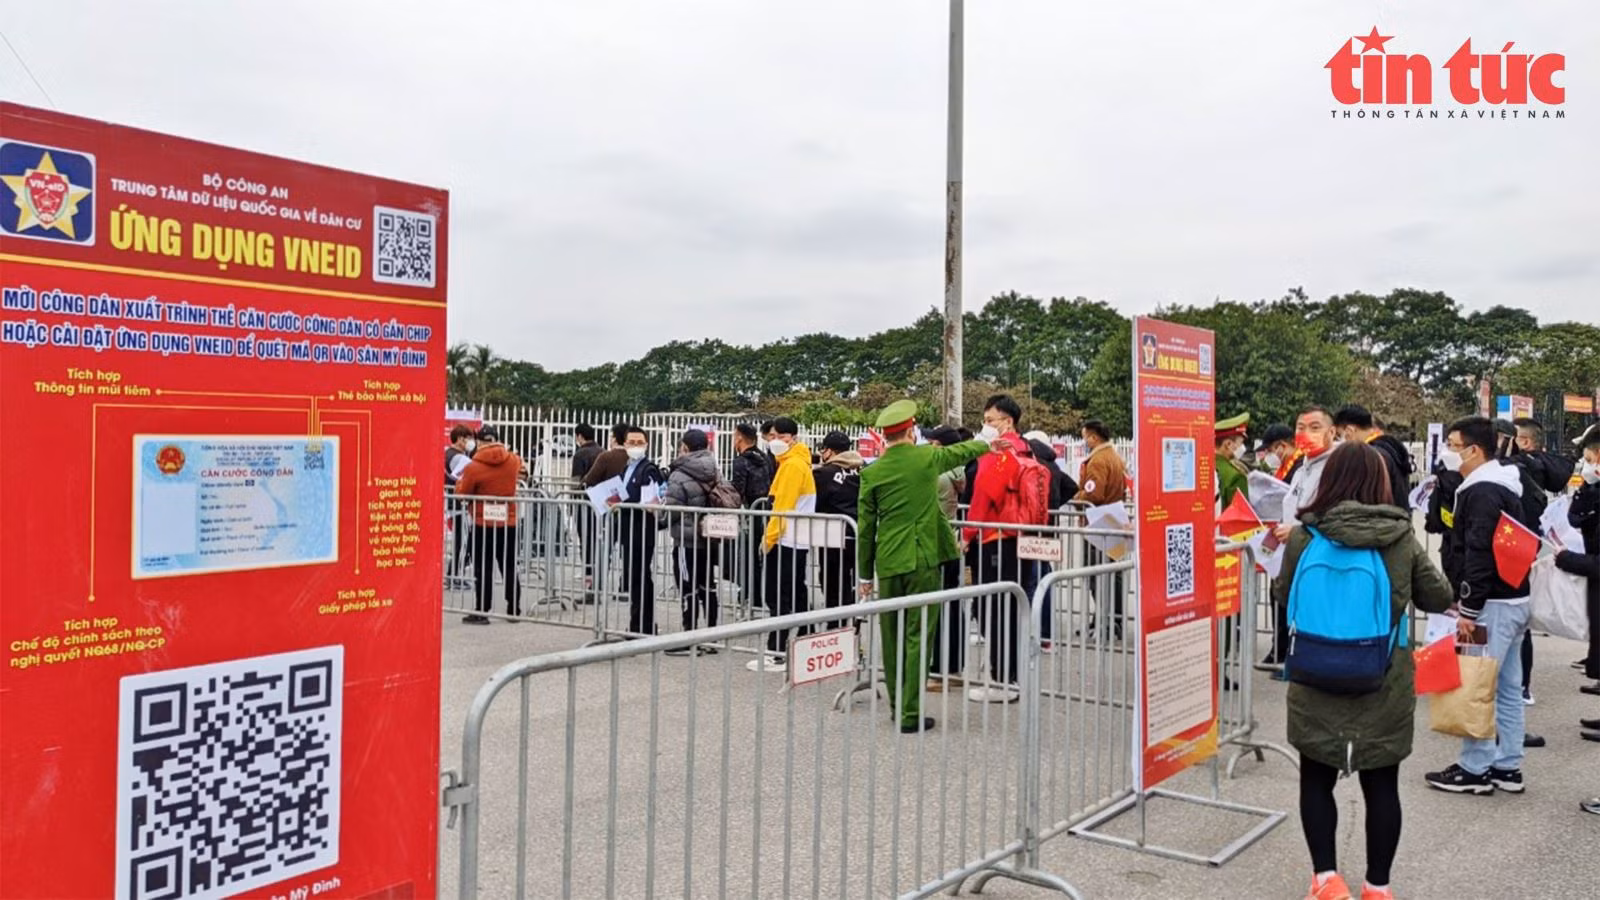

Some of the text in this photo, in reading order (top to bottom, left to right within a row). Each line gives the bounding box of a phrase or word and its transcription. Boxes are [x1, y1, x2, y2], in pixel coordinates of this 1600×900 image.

[203, 173, 289, 200] BỘ CÔNG AN
[111, 178, 157, 198] TRUNG
[161, 186, 188, 203] TÂM
[191, 191, 211, 206] DỮ
[213, 194, 237, 212] LIỆU
[240, 199, 277, 217] QUỐC
[280, 207, 301, 221] GIA
[319, 213, 343, 228] DÂN
[346, 218, 363, 231] CƯ
[110, 203, 362, 279] ỨNG DỤNG VNEID
[3, 285, 37, 311] MỜI
[40, 288, 86, 315] CÔNG
[87, 293, 122, 318] DÂN
[124, 296, 163, 321] XUẤT
[166, 301, 208, 326] TRÌNH
[210, 303, 236, 328] THẺ
[237, 307, 266, 330] CĂN
[268, 311, 301, 333] CƯỚC
[303, 313, 336, 336] CÔNG
[338, 316, 363, 337] DÂN
[364, 319, 381, 339] CÓ
[406, 325, 431, 342] CHIP
[3, 319, 49, 348] HOẶC
[51, 322, 80, 346] CÀI
[82, 324, 114, 352] ĐẶT
[115, 326, 148, 352] ỨNG
[150, 331, 192, 357] DỤNG
[193, 335, 235, 356] VNEID
[236, 332, 255, 358] ĐỂ
[256, 338, 289, 361] QUÉT
[312, 344, 330, 363] QR
[331, 342, 355, 364] VÀO
[356, 344, 380, 365] SÂN
[400, 347, 428, 368] ĐÌNH
[67, 368, 121, 383] Tích hợp
[363, 379, 382, 390] Tích
[34, 382, 151, 397] Thông tin mũi tiêm
[337, 589, 356, 600] Tích
[64, 616, 118, 631] Tích hợp
[11, 625, 162, 652] Chế độ chính sách theo
[811, 637, 839, 649] POLICE
[10, 637, 166, 669] nghị quyết NQ68/NQ-CP
[806, 651, 843, 672] STOP
[312, 876, 341, 896] Đình
